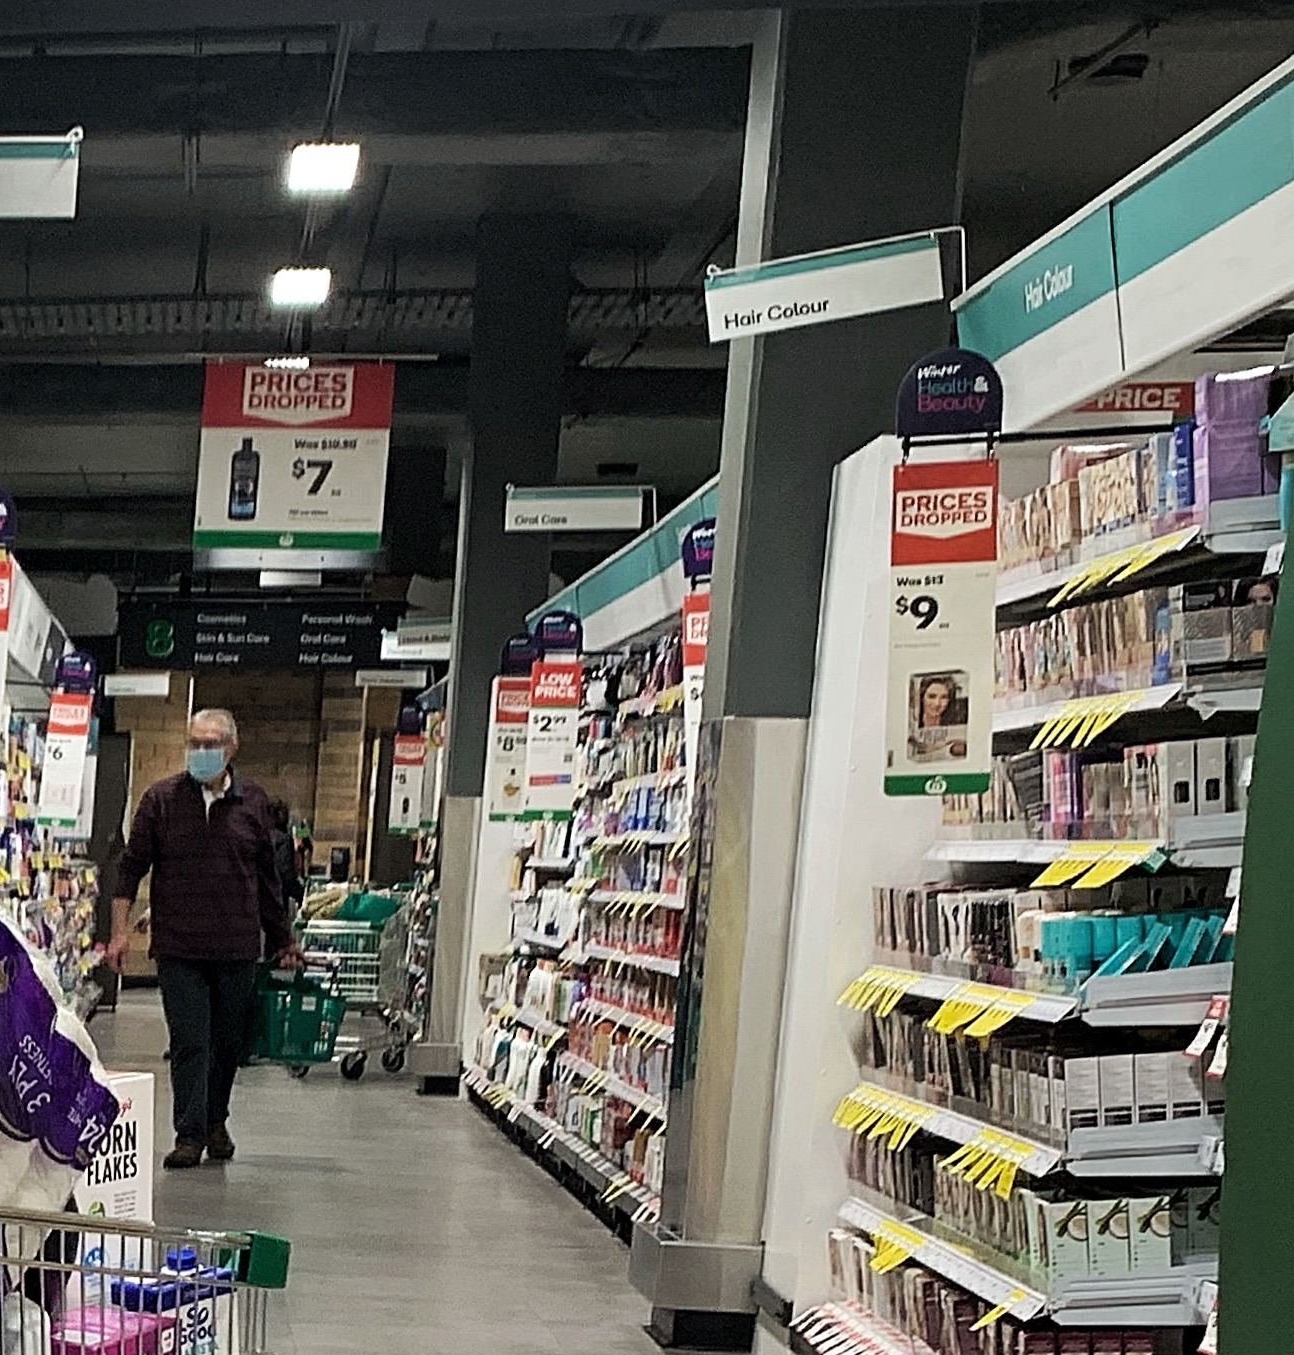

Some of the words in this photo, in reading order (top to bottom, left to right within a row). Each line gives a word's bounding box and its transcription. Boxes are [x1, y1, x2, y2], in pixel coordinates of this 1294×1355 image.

[725, 310, 764, 330] Hair
[768, 299, 830, 322] Colour
[250, 371, 348, 393] PRICES
[248, 394, 347, 410] DROPPED
[917, 394, 988, 415] Beauty
[1097, 386, 1182, 410] PRICE
[292, 456, 334, 497] $7
[900, 491, 988, 514] PRICES
[900, 509, 988, 528] DROPPED
[895, 594, 939, 631] $9
[145, 619, 175, 658] 8
[540, 672, 574, 685] LOW
[534, 686, 577, 700] PRICE
[93, 1120, 137, 1158] ORN
[87, 1152, 138, 1186] FLAKES
[185, 1305, 212, 1330] SO
